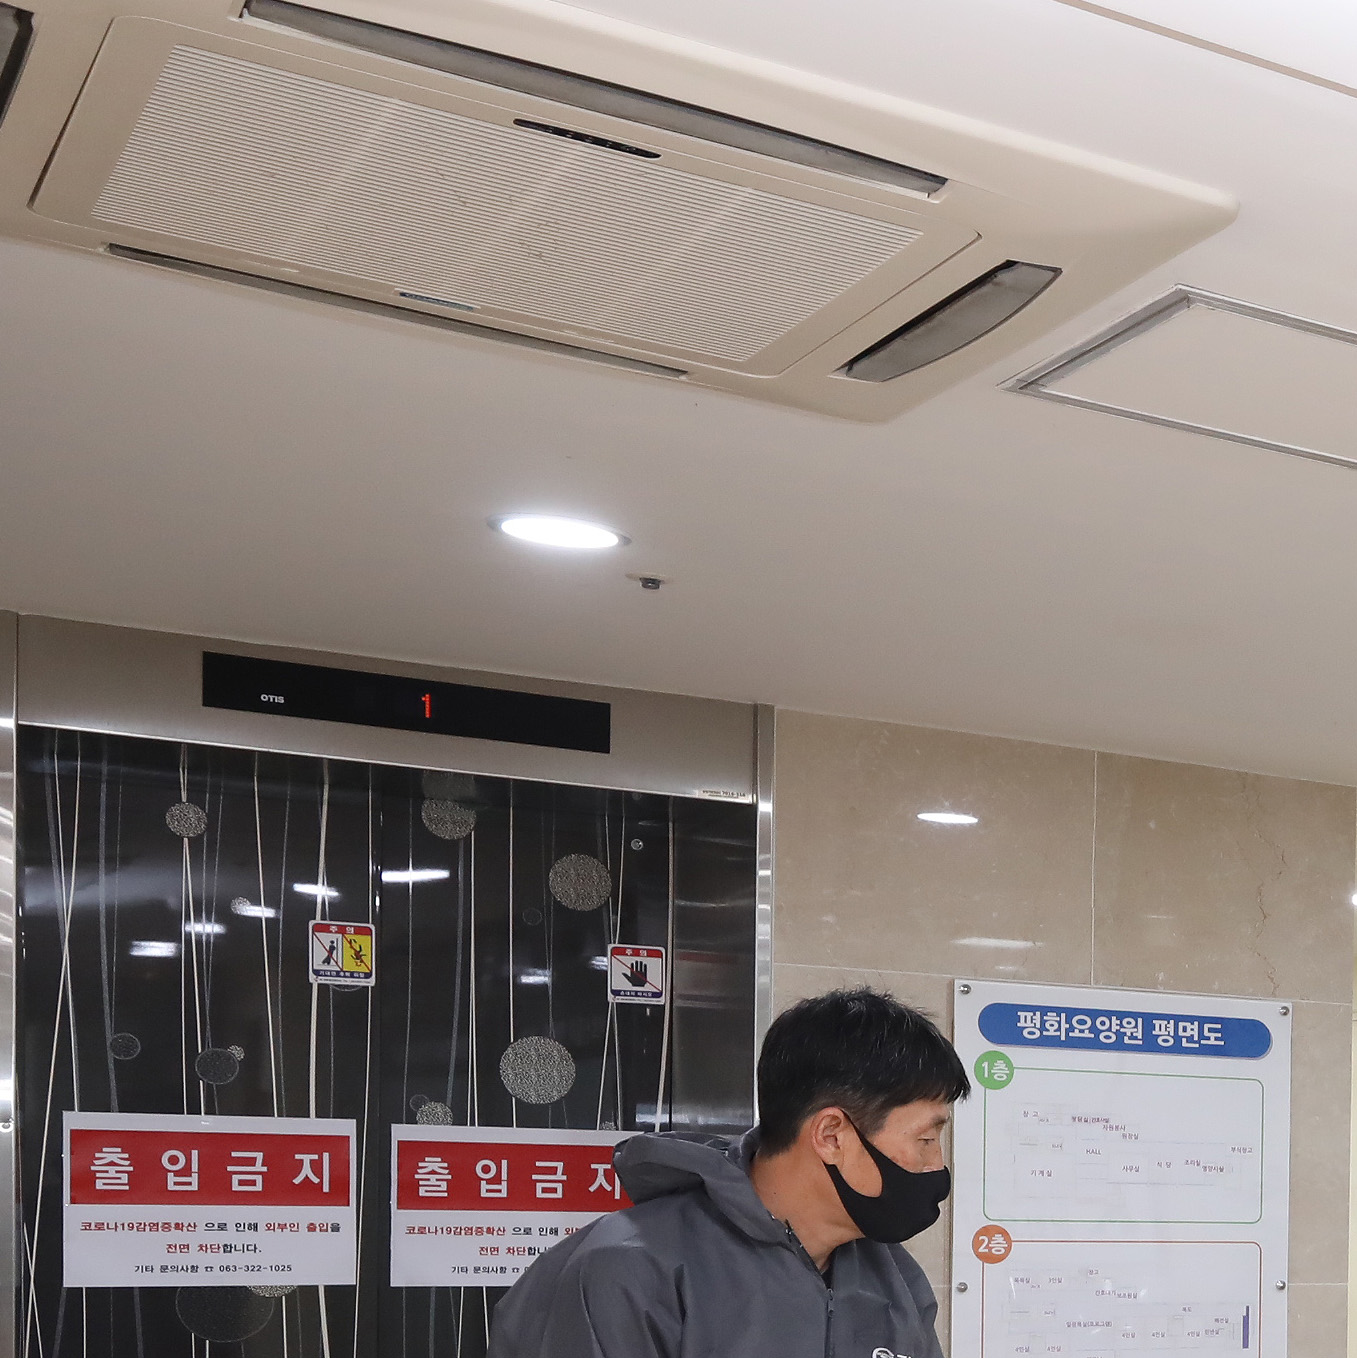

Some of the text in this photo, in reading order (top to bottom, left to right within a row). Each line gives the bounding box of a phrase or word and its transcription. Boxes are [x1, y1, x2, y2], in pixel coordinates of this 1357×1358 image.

[260, 694, 285, 704] OTIS
[421, 693, 432, 718] 1
[1017, 1010, 1225, 1048] 평화요양원 평면도
[982, 1060, 1010, 1081] 1층
[90, 1147, 331, 1193] 출입금지
[1122, 1165, 1140, 1173] 사무실
[414, 1157, 622, 1200] 출입금지
[80, 1222, 341, 1232] 코로나19감염증확산 으로 인해 외부인 출입을
[404, 1226, 506, 1236] 코로나19감염증확산
[512, 1226, 532, 1236] 으로
[538, 1226, 559, 1236] 인해
[166, 1243, 262, 1254] 전면 차단합니다.
[978, 1234, 1008, 1255] 2층
[478, 1246, 500, 1256] 전면
[134, 1264, 292, 1274] 기타 문의사항 063-322-1025
[451, 1266, 508, 1274] 기타 문의사항
